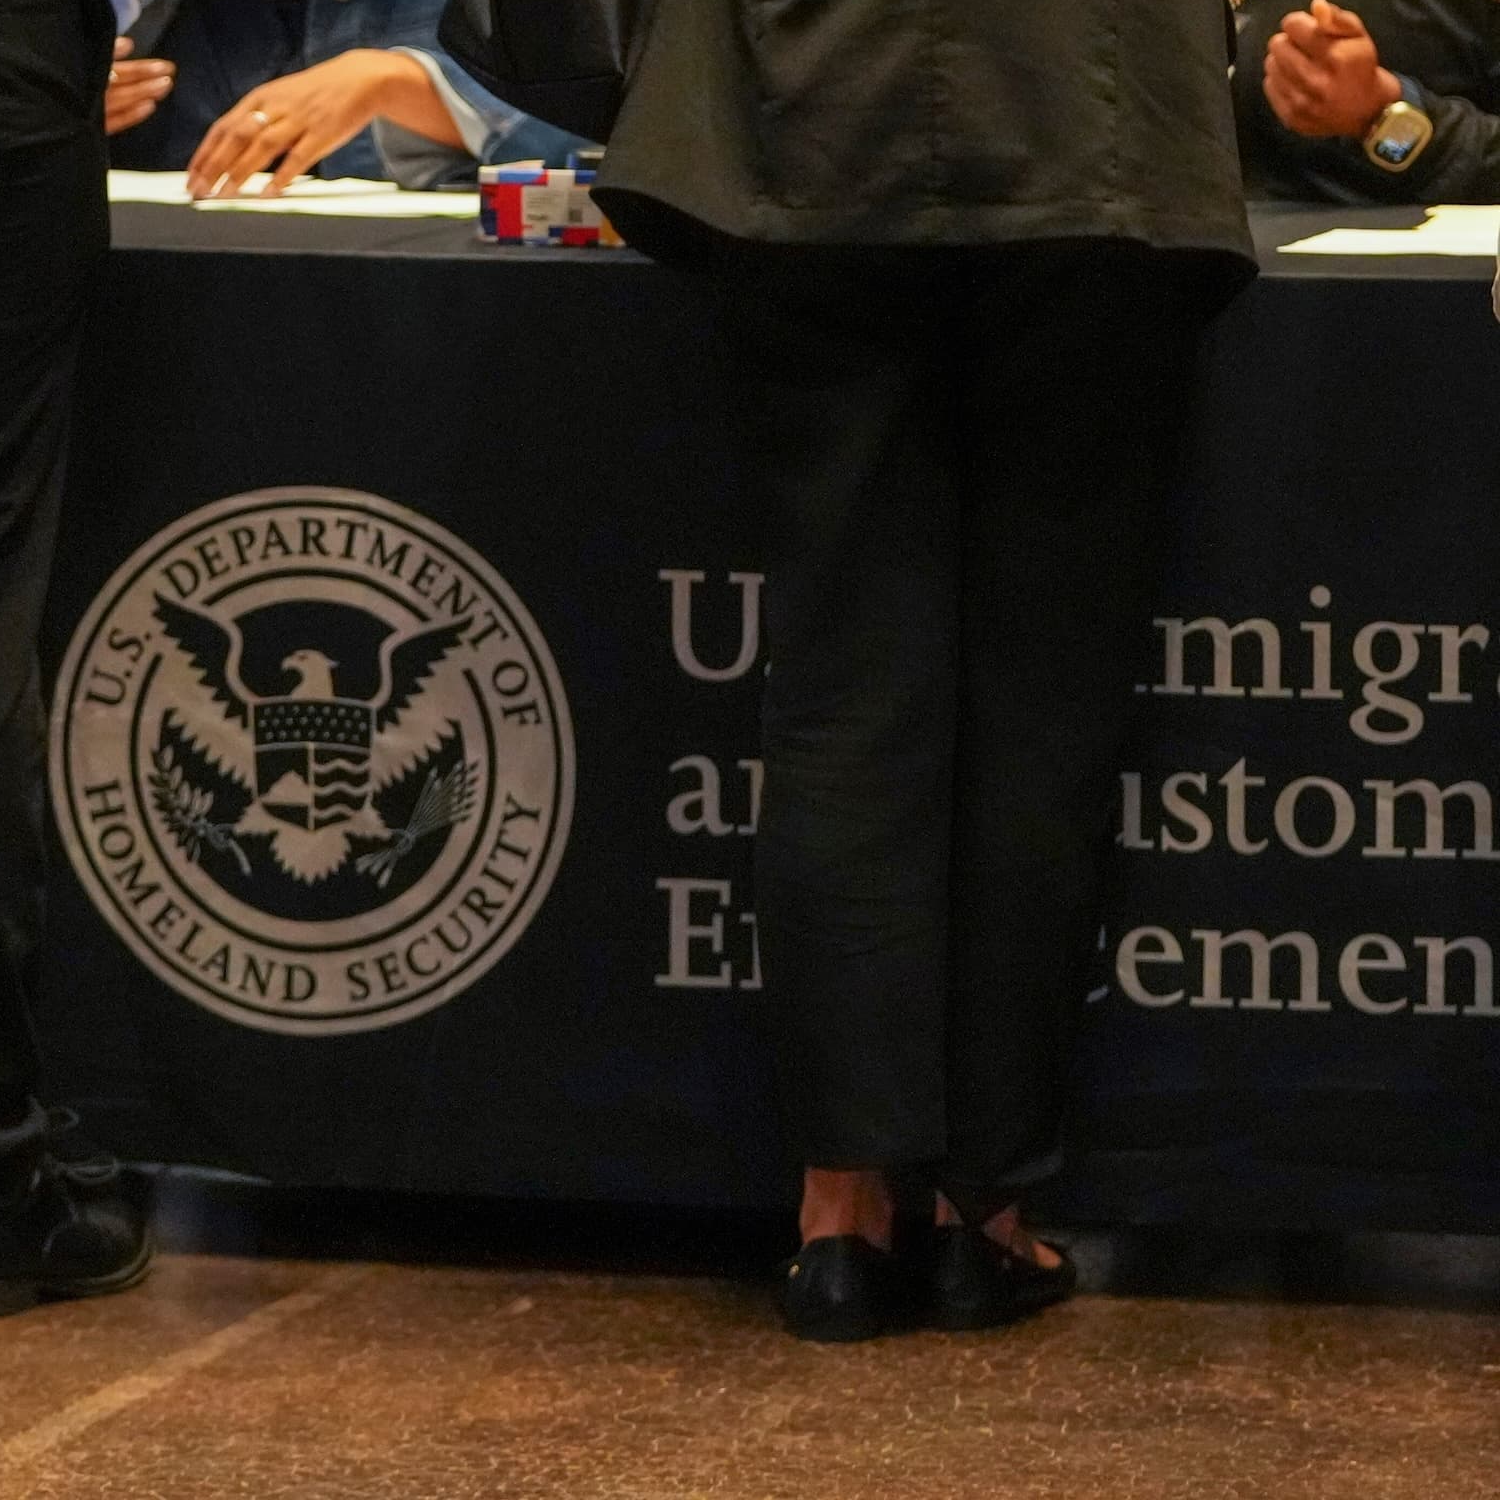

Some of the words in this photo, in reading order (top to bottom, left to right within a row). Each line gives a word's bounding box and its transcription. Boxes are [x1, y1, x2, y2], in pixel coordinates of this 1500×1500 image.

[87, 626, 151, 708] U.S.
[162, 517, 509, 657] DEPARTMENT
[492, 661, 543, 730] OF
[84, 779, 317, 1002] HOMELAND
[346, 796, 540, 1002] SECURITY
